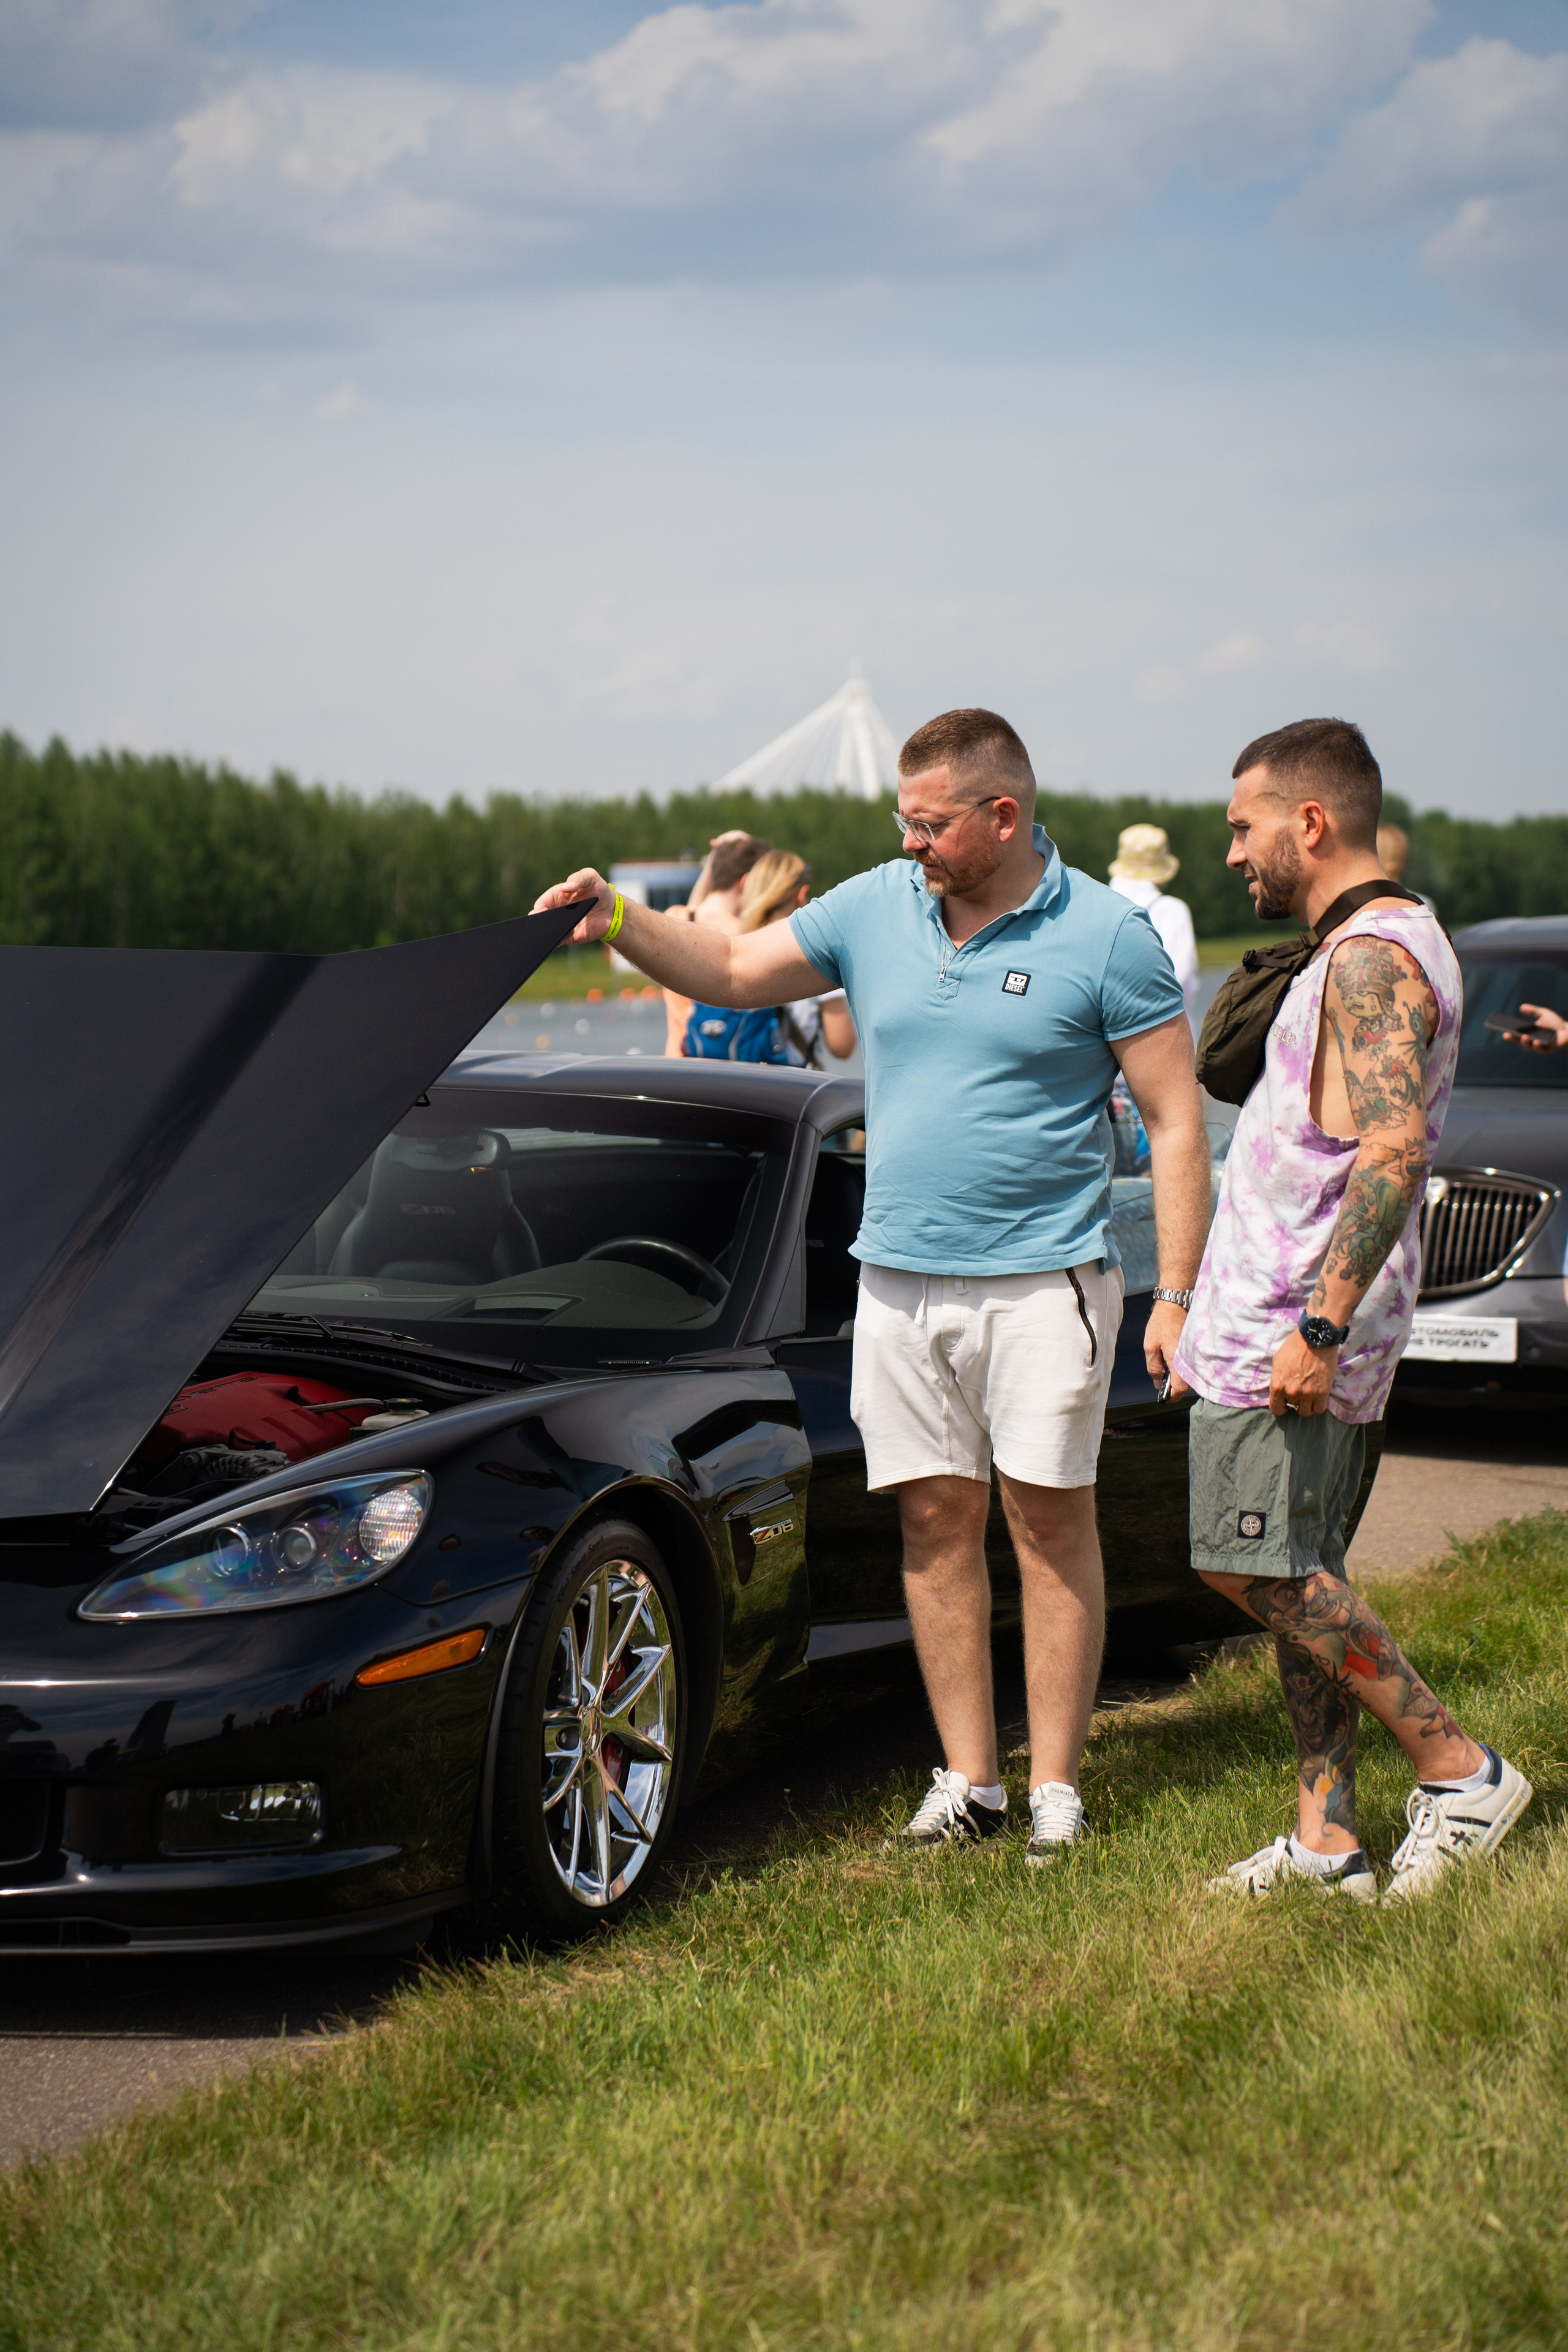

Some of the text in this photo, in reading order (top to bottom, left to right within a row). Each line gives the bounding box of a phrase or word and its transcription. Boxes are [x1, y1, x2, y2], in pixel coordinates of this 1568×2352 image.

[1005, 984, 1023, 993] DIESEL
[1429, 1338, 1488, 1349] ТРОГАТЬ
[752, 1521, 794, 1545] Z06
